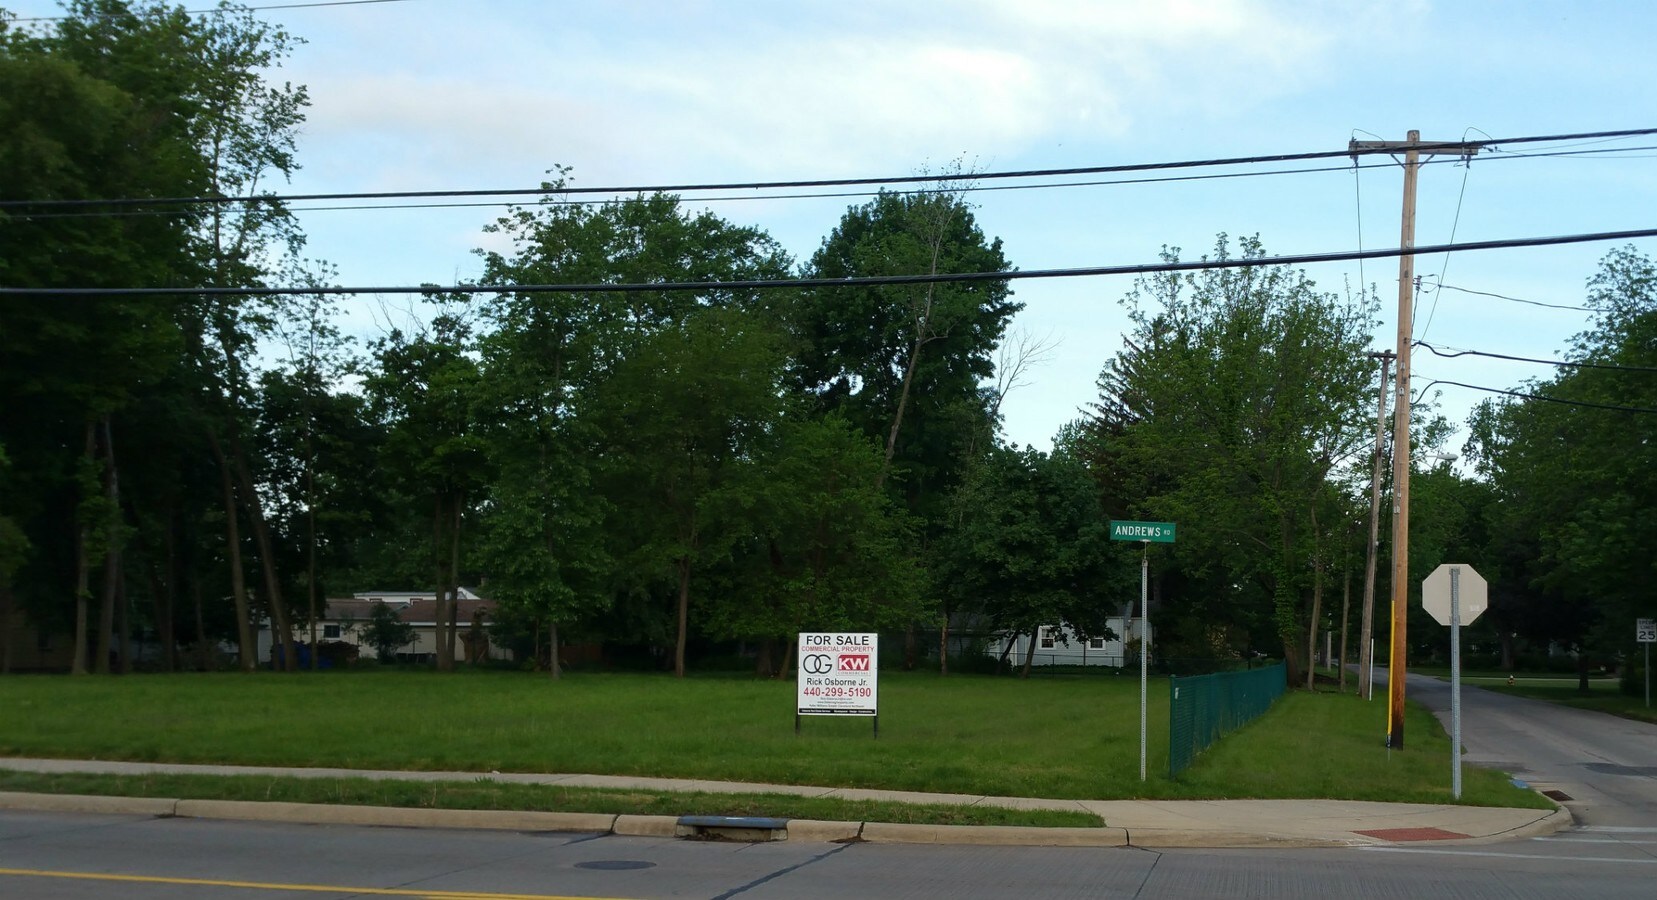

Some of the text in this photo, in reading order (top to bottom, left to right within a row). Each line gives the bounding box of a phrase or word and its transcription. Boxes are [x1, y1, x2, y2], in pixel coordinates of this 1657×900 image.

[1115, 525, 1161, 537] ANDREWS
[1639, 630, 1656, 640] 25
[806, 636, 869, 646] FOR SALE
[838, 657, 869, 670] KW
[806, 677, 868, 687] Rick Osborne Jr.
[804, 687, 872, 697] 440-299-5190
